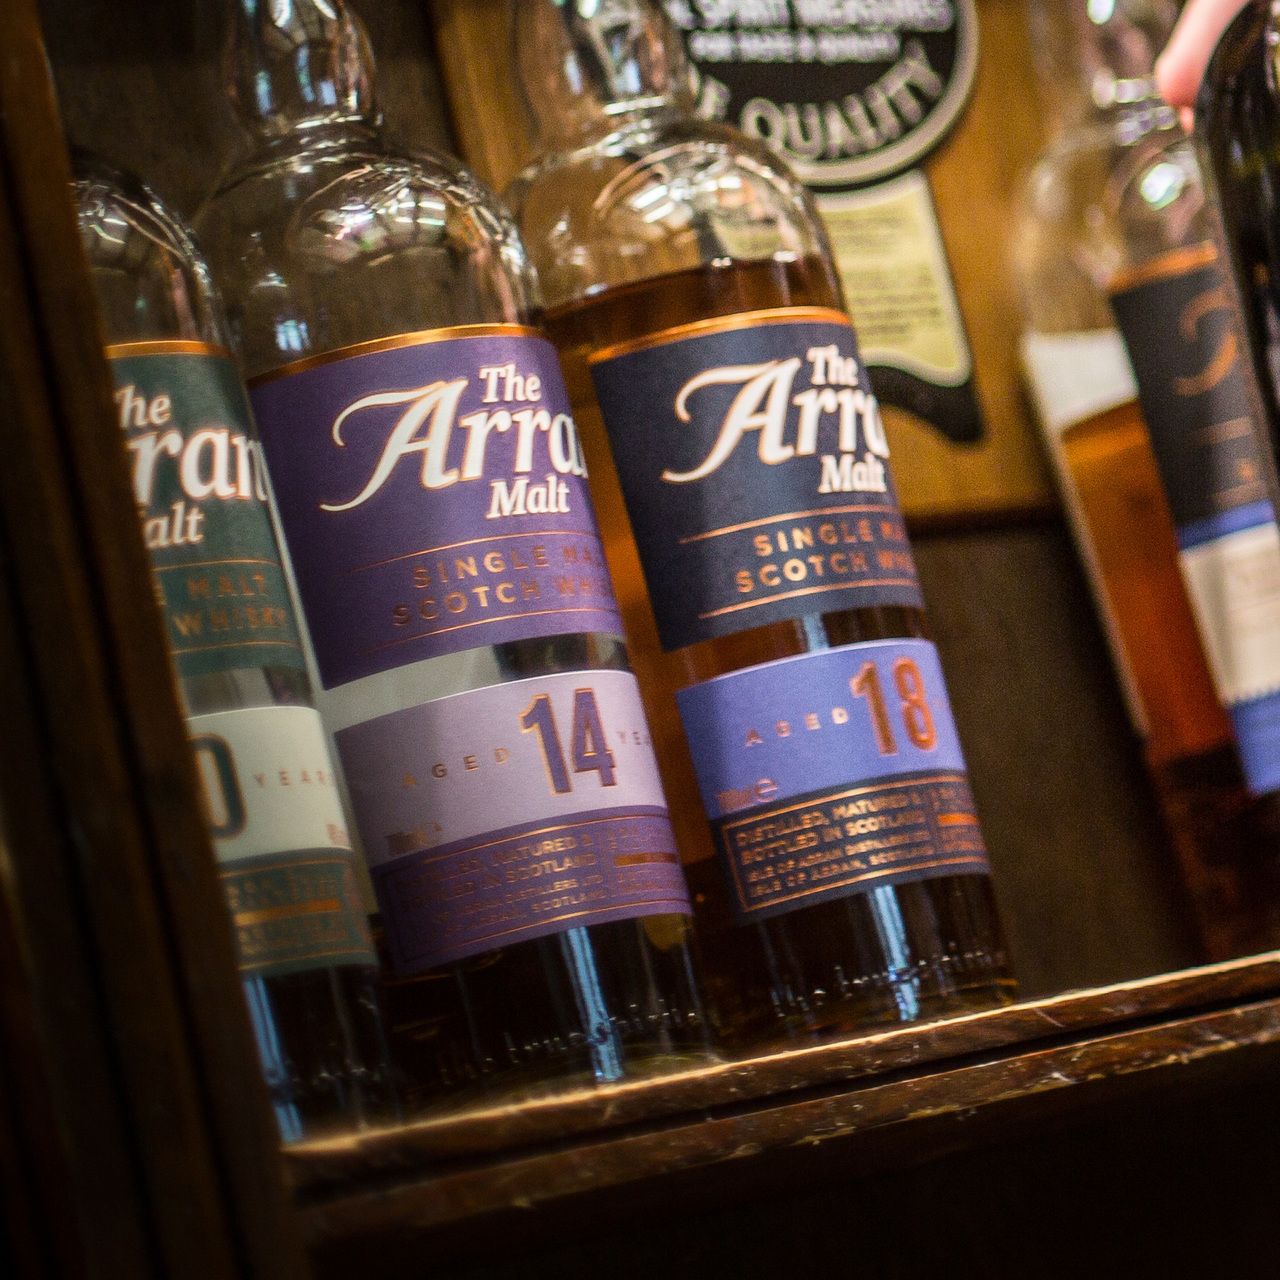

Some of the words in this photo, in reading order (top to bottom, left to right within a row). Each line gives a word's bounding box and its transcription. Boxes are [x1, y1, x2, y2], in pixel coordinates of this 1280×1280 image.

[740, 38, 943, 160] QUALITY
[480, 364, 542, 404] The
[806, 344, 859, 386] The
[108, 384, 171, 431] he
[126, 428, 270, 504] ran
[320, 380, 589, 513] Arra
[818, 452, 888, 494] Malt
[486, 476, 572, 520] Malt
[143, 498, 205, 550] alt
[753, 520, 873, 557] SINGLE
[186, 572, 267, 598] MALT
[412, 545, 550, 590] SINGLE
[735, 549, 868, 593] SCOTCH
[393, 582, 542, 627] SCOTCH
[745, 707, 850, 747] AGED
[849, 656, 938, 757] 18
[402, 747, 511, 790] AGED
[517, 687, 619, 797] 14
[254, 768, 332, 789] YEAR
[506, 854, 596, 884] SCOTLAND
